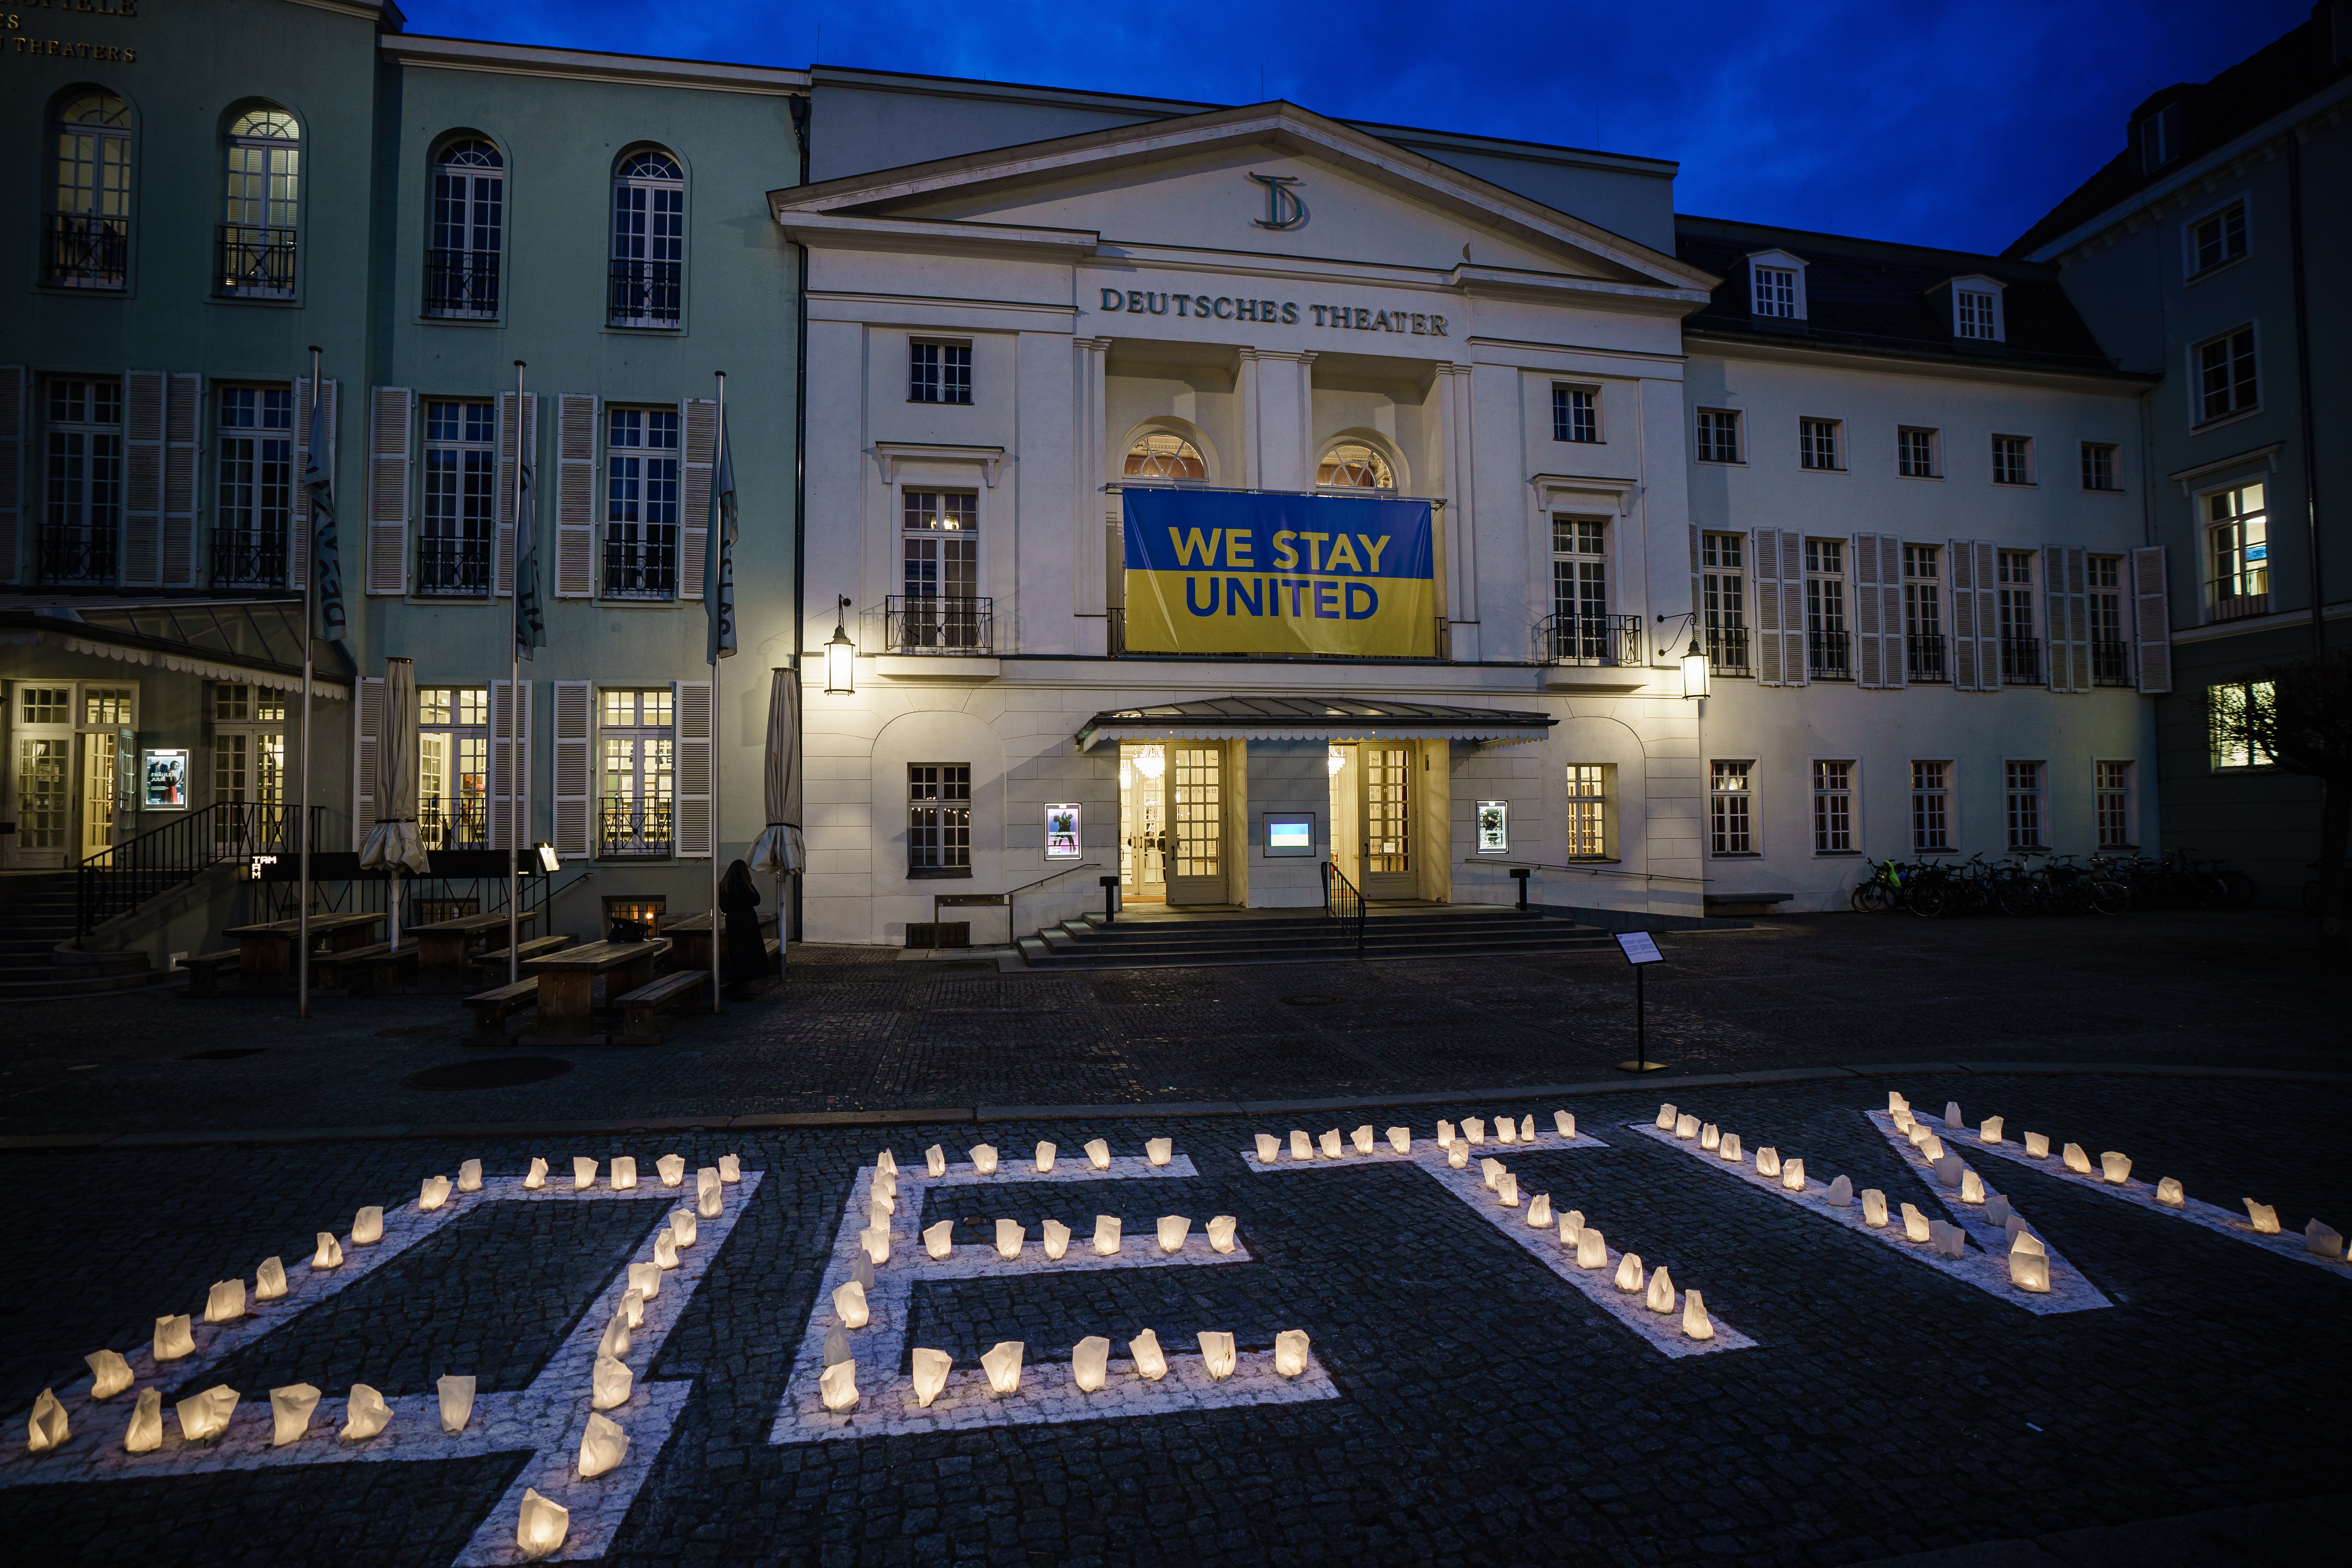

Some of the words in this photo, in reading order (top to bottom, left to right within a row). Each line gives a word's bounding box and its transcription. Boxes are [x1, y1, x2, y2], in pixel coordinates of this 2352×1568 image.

[13, 38, 135, 62] THEATERS
[1100, 288, 1297, 324] DEUTSCHES
[1310, 304, 1447, 336] THEATER
[1168, 527, 1254, 567] WE
[1272, 530, 1391, 572] STAY
[1186, 577, 1378, 620] UNITED
[252, 856, 277, 864] TAM
[283, 902, 320, 912] RESTAANT
